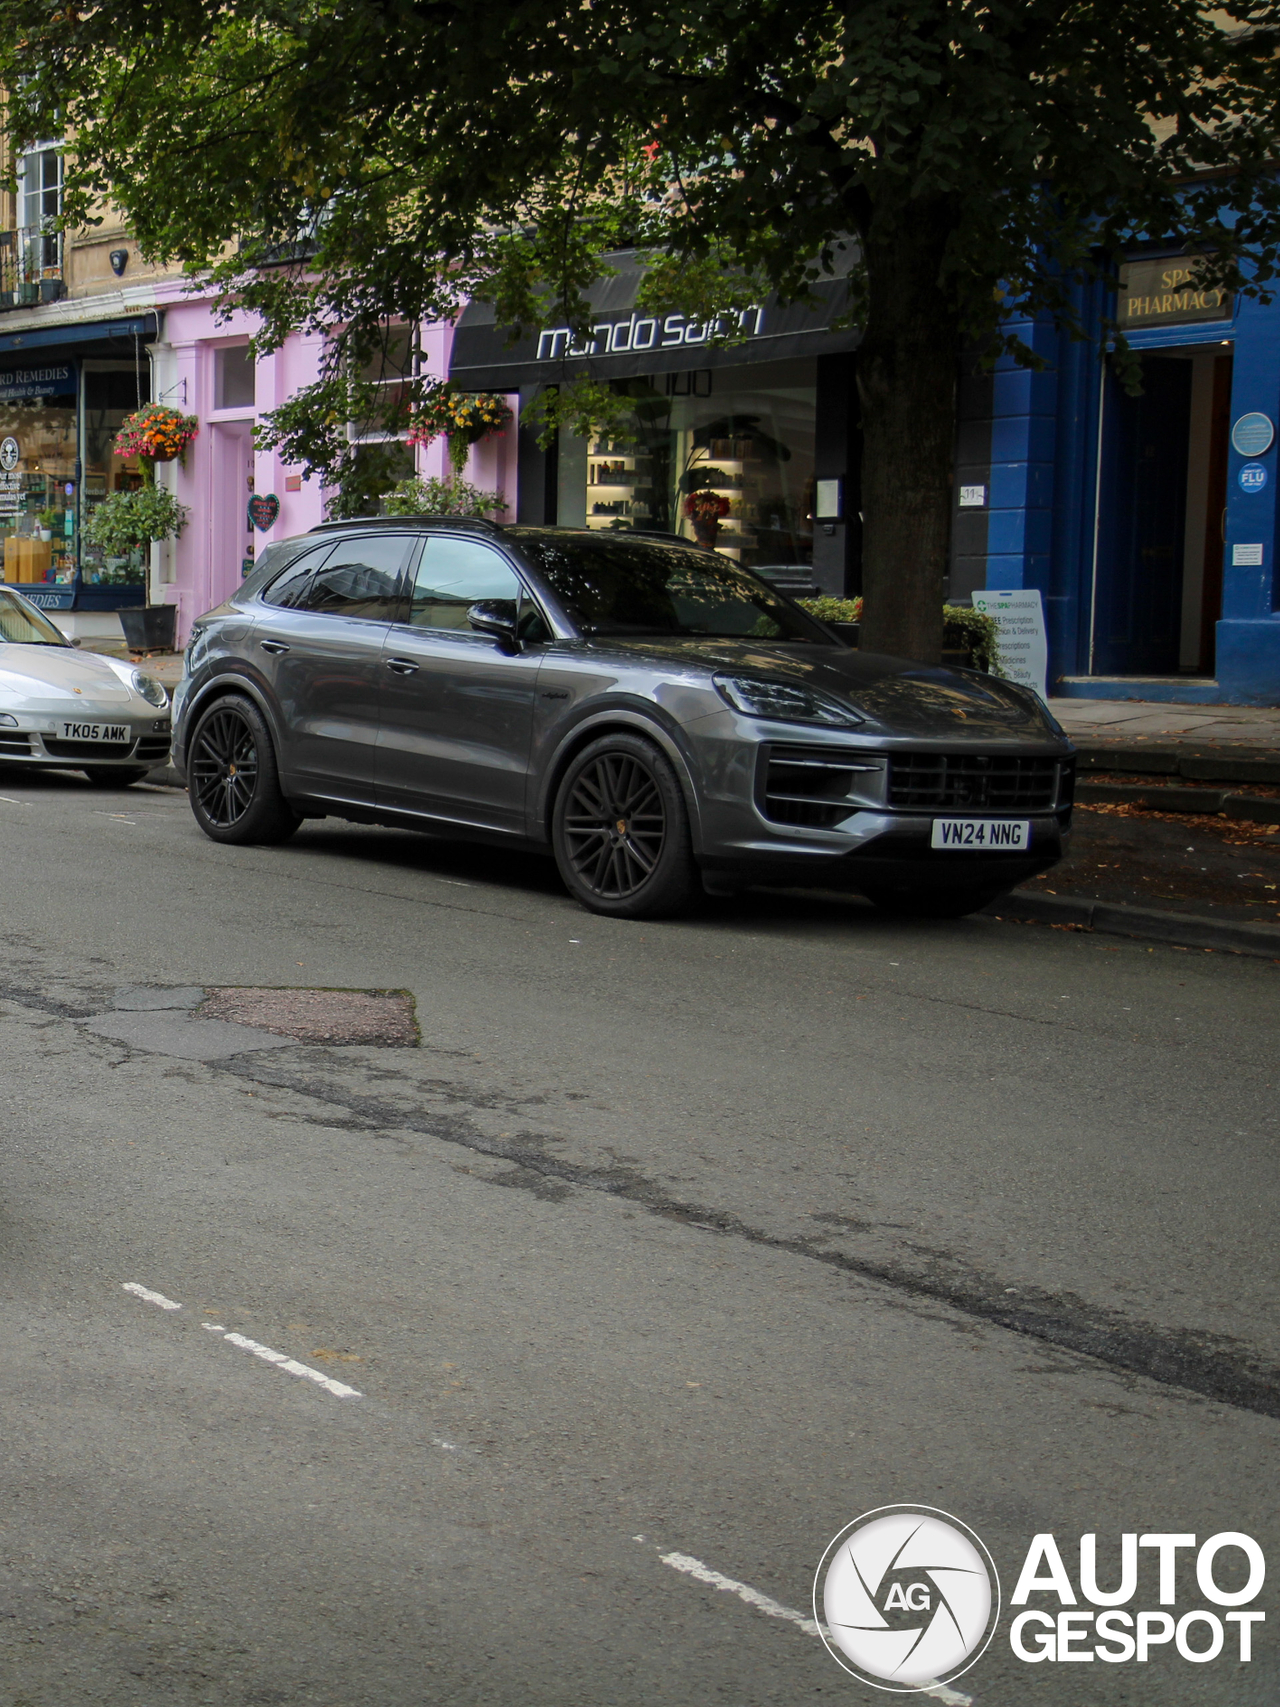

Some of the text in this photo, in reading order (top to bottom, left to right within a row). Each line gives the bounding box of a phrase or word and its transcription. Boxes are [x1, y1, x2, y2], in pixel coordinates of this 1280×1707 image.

[1127, 288, 1227, 317] PHARMACY
[15, 366, 69, 384] REMEDIES
[8, 388, 26, 398] Health
[26, 386, 35, 396] &
[34, 385, 55, 396] Beauty
[7, 471, 22, 480] most
[1241, 472, 1265, 483] FLU
[16, 491, 26, 503] yet
[1002, 616, 1034, 625] Prescription
[1017, 626, 1039, 637] Delivery
[1013, 670, 1032, 680] Beauty
[63, 722, 127, 741] TK05 AMK
[942, 822, 1021, 845] VN24 NNG
